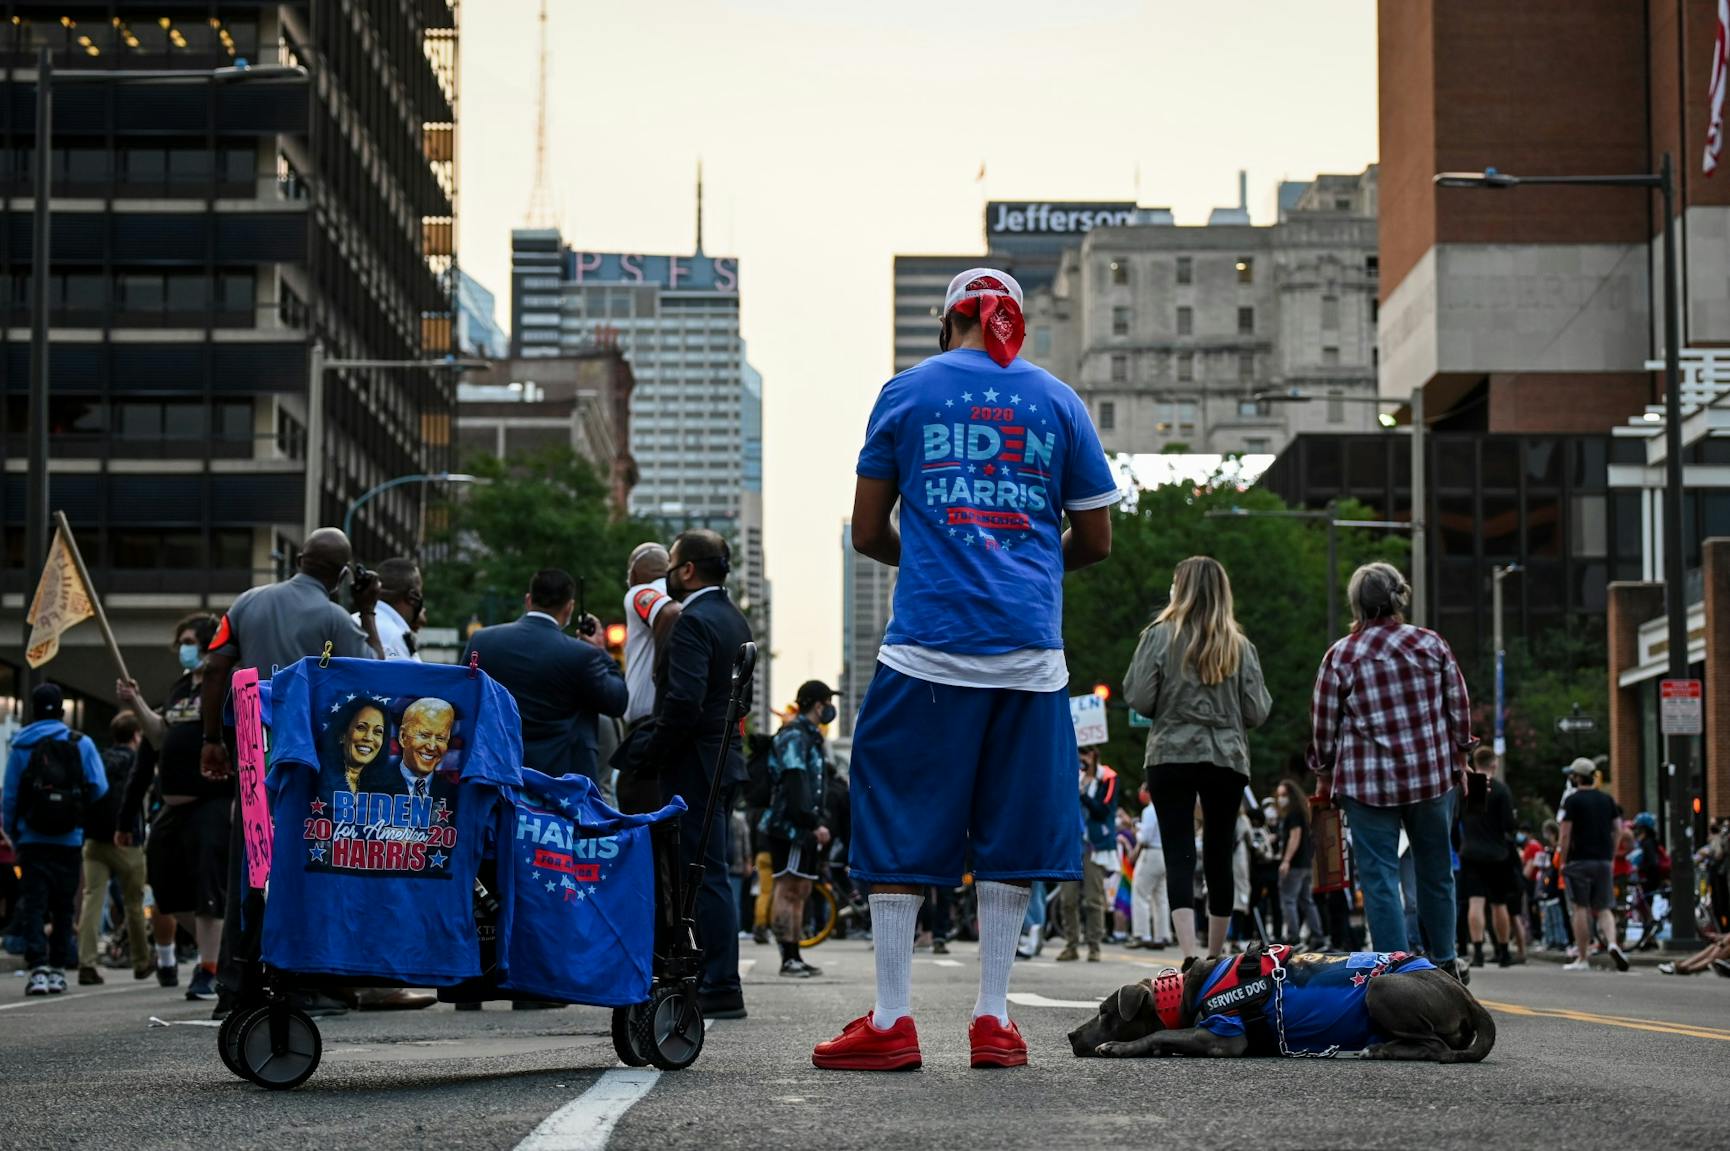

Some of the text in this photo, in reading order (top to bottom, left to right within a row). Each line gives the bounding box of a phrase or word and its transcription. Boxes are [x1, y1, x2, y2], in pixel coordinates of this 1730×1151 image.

[994, 203, 1137, 232] Jefferson
[575, 252, 738, 292] PSFS
[970, 406, 1014, 422] 2020
[923, 423, 1055, 468] BIDEN
[925, 476, 1047, 512] HARRIS
[333, 791, 434, 829] BIDEN
[303, 818, 458, 848] 20 for America 20
[332, 838, 428, 871] HARRIS
[1207, 978, 1268, 1011] SERVICE DOG
